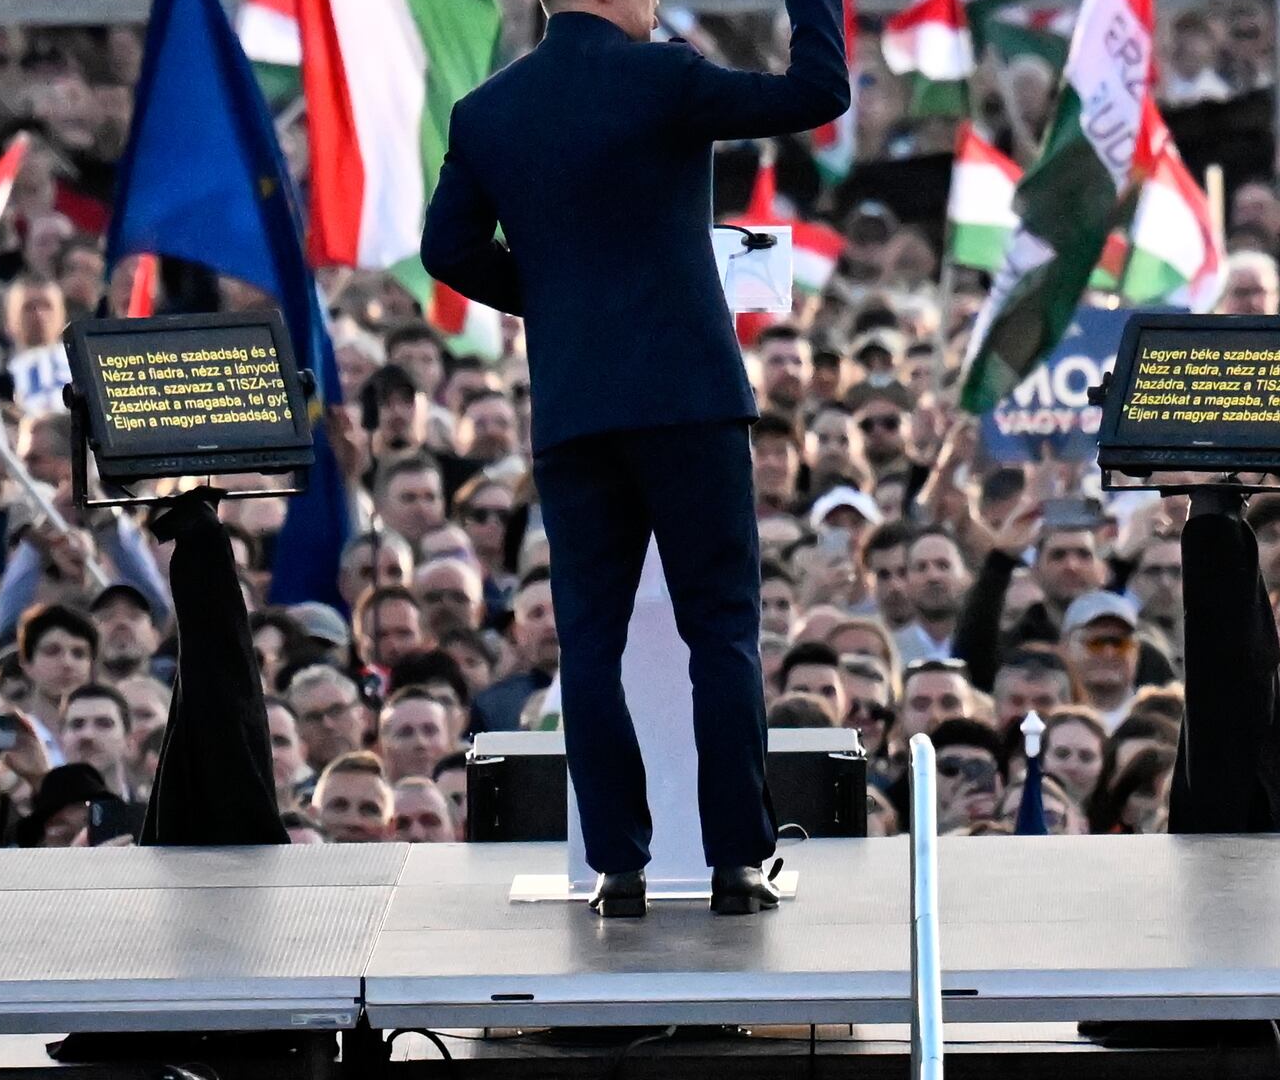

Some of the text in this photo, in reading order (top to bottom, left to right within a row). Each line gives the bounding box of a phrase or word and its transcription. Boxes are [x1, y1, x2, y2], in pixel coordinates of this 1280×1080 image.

[98, 355, 144, 368] Legyen
[147, 352, 178, 364] béke
[181, 347, 247, 364] szabadság
[251, 346, 266, 358] és
[1141, 348, 1187, 364] Legyen
[1190, 349, 1220, 360] béke
[102, 366, 135, 382] Nézz
[138, 371, 146, 380] a
[149, 367, 188, 379] fiadra,
[191, 365, 221, 377] nézz
[224, 366, 232, 375] a
[1139, 361, 1170, 374] Nézz
[1173, 366, 1181, 374] a
[1185, 364, 1221, 376] fiadra,
[1226, 364, 1255, 375] nézz
[1258, 367, 1266, 375] a
[106, 377, 284, 400] hazádra, szavazz a TISZA-ra
[1135, 378, 1186, 391] hazádra,
[1191, 381, 1241, 390] szavazz
[1244, 382, 1251, 390] a
[110, 396, 171, 415] Zászlókat
[174, 400, 181, 410] a
[184, 395, 245, 413] magasba,
[248, 393, 264, 405] fel
[1131, 393, 1190, 405] Zászlókat
[1193, 396, 1201, 405] a
[1205, 395, 1263, 408] magasba,
[113, 412, 146, 431] Éljen
[149, 417, 158, 427] a
[160, 412, 206, 428] magyar
[210, 406, 280, 423] szabadság,
[1127, 406, 1158, 422] Éljen
[1162, 411, 1170, 419] a
[1173, 411, 1220, 423] magyar
